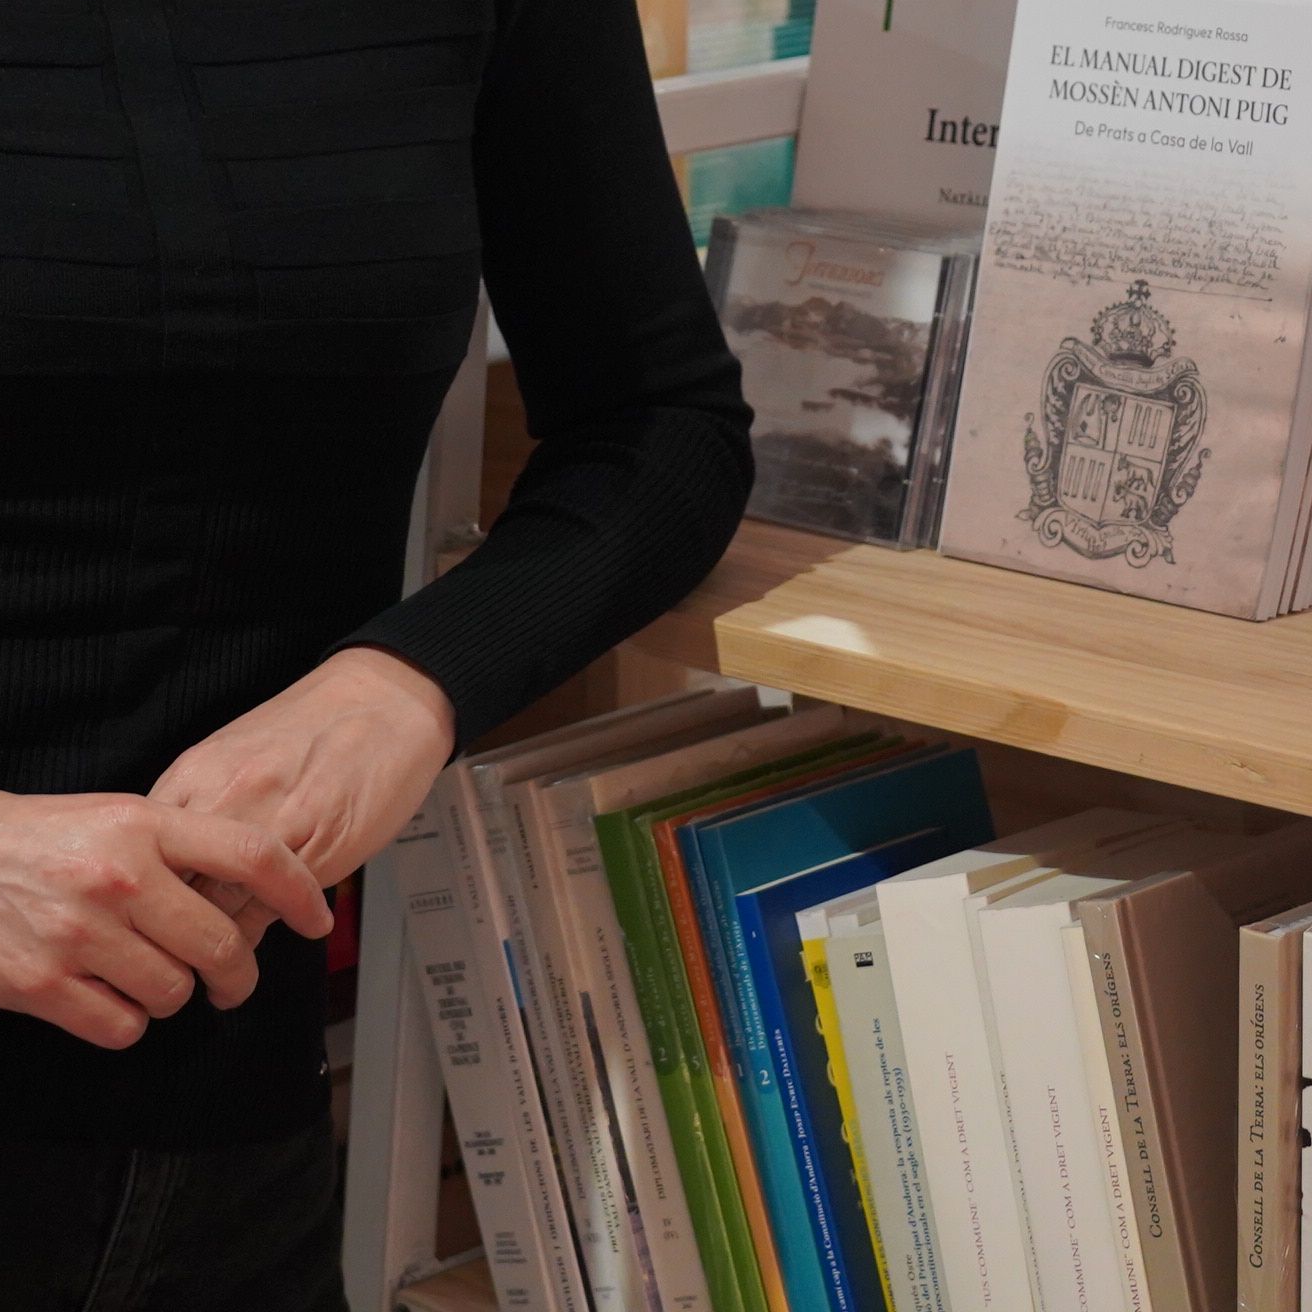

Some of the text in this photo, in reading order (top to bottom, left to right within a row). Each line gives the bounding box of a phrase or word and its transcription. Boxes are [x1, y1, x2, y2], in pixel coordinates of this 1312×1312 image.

[1104, 16, 1248, 42] Francesc Rodríguez Rossa
[1050, 44, 1292, 90] EL MANUAL DIGEST DE
[1049, 79, 1288, 125] MOSSÈN ANTONI PUIG
[1074, 120, 1253, 156] De Prats a Casa de la Vall
[871, 1019, 880, 1033] les
[874, 1036, 883, 1050] de
[759, 1070, 770, 1085] 2
[879, 1052, 892, 1086] reptes
[946, 1052, 959, 1104] VIGENT
[883, 1090, 893, 1105] als
[1048, 1086, 1061, 1137] VIGENT
[889, 1108, 903, 1153] resposta
[954, 1107, 966, 1144] DRET
[801, 1144, 818, 1192] d'Andorra
[896, 1157, 904, 1166] la
[906, 1150, 920, 1178] segle
[960, 1145, 968, 1157] A
[1056, 1140, 1068, 1179] DRET
[963, 1158, 973, 1193] COM
[1062, 1182, 1070, 1193] A
[1099, 1106, 1130, 1249] COM A DRET VIGENT
[917, 1195, 924, 1209] en
[1064, 1195, 1075, 1229] COM
[813, 1193, 831, 1248] Constitució
[825, 1250, 834, 1260] la
[911, 1230, 927, 1278] Principat
[831, 1268, 842, 1284] cap
[920, 1283, 929, 1299] del
[835, 1286, 846, 1309] camí
